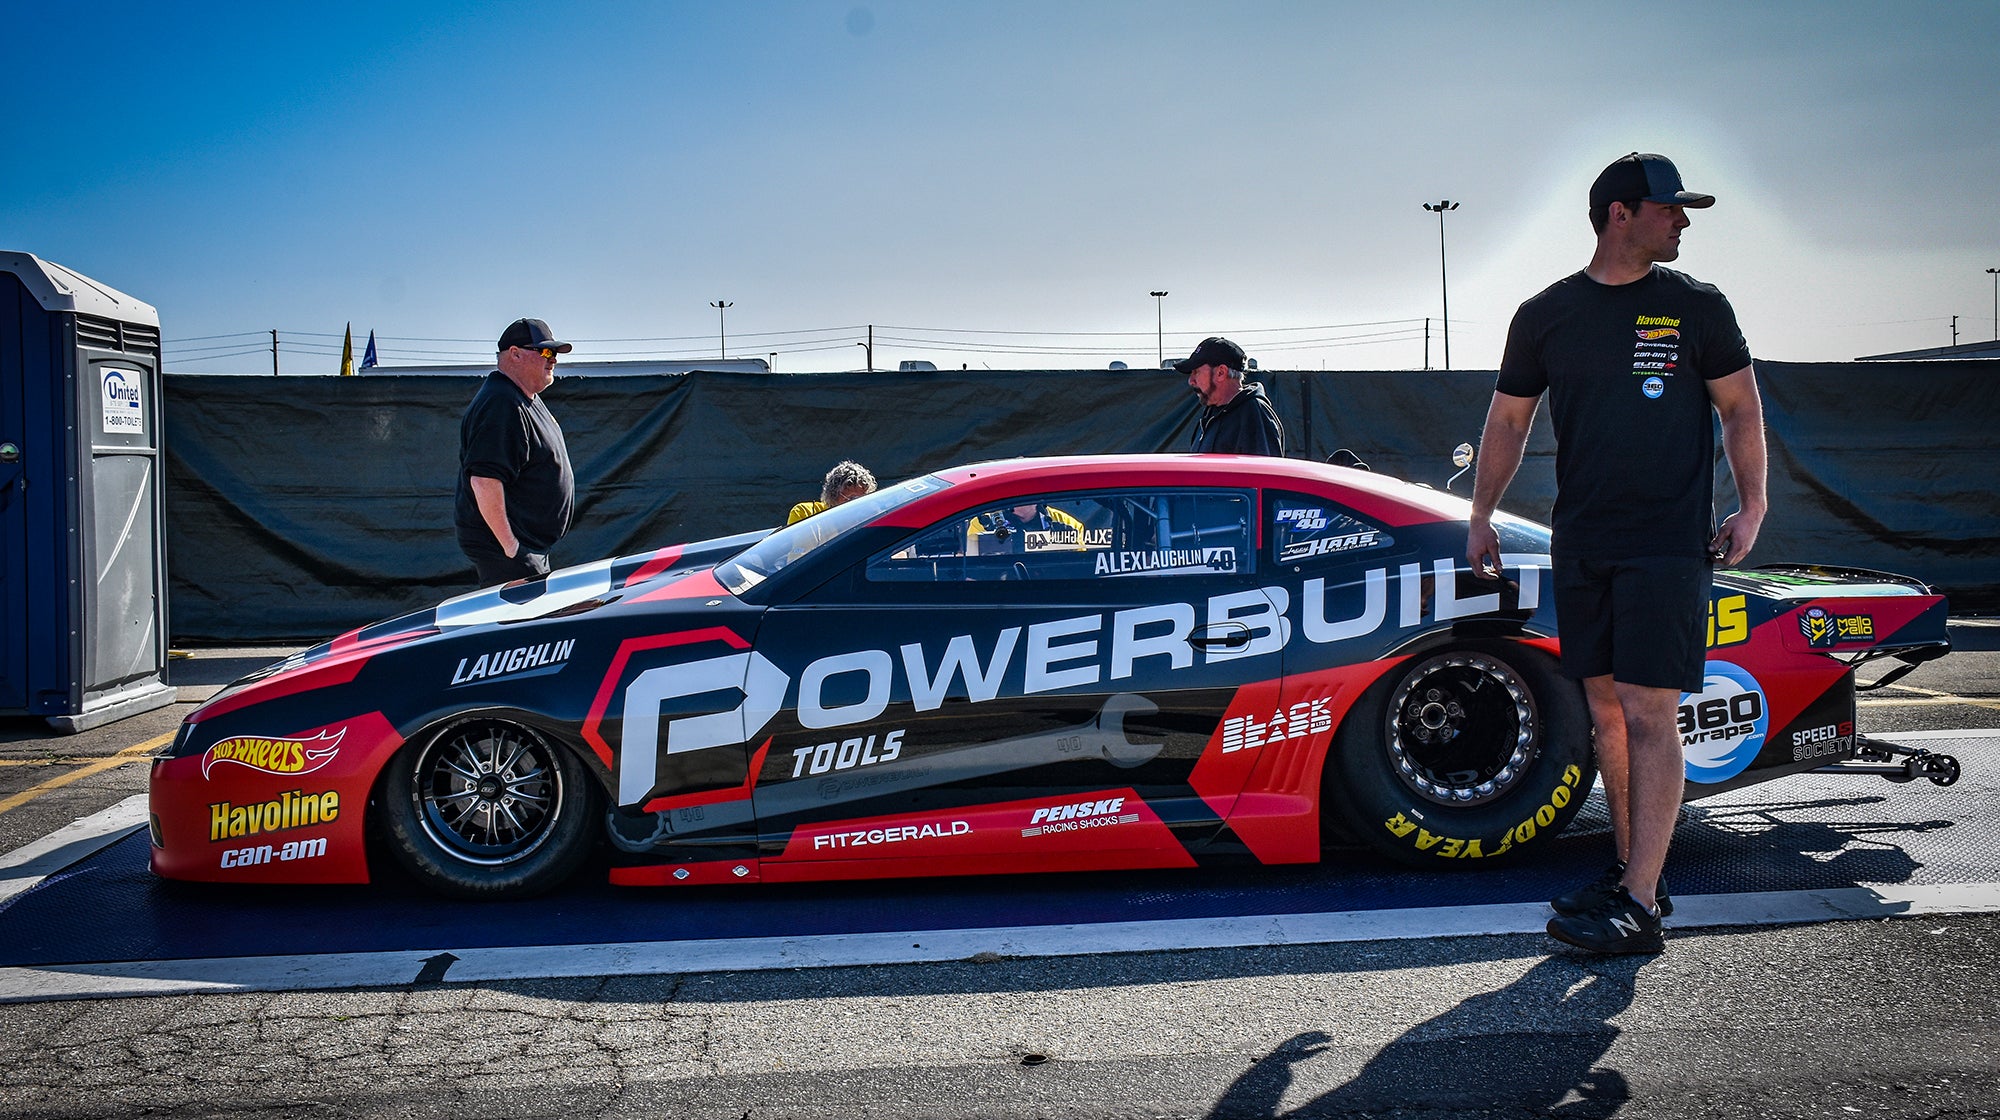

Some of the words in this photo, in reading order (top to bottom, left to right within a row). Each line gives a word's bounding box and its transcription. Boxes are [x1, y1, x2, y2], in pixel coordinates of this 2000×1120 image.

[1636, 315, 1680, 327] Havoline
[108, 381, 138, 401] United
[1277, 508, 1321, 521] PRO
[1296, 518, 1326, 529] 40
[1308, 533, 1374, 555] HAAS
[1206, 550, 1236, 571] 40
[450, 638, 575, 685] LAUGHLIN
[619, 554, 1552, 806] POWERBUILT
[1223, 696, 1332, 737] BLACK
[1677, 692, 1762, 734] 360
[1222, 715, 1332, 754] BEARD
[1682, 723, 1754, 746] wraps
[1792, 724, 1836, 746] SPEED
[1793, 734, 1853, 762] SOCIETY
[213, 741, 235, 760] HOT
[231, 738, 305, 772] WHEELS
[792, 730, 905, 778] TOOLS
[210, 790, 339, 841] Havoline
[1030, 797, 1125, 824] PENSKE
[814, 821, 970, 850] FITZGERALD
[1043, 820, 1078, 835] RACING
[1080, 816, 1118, 830] SHOCKS
[220, 837, 327, 869] can-am
